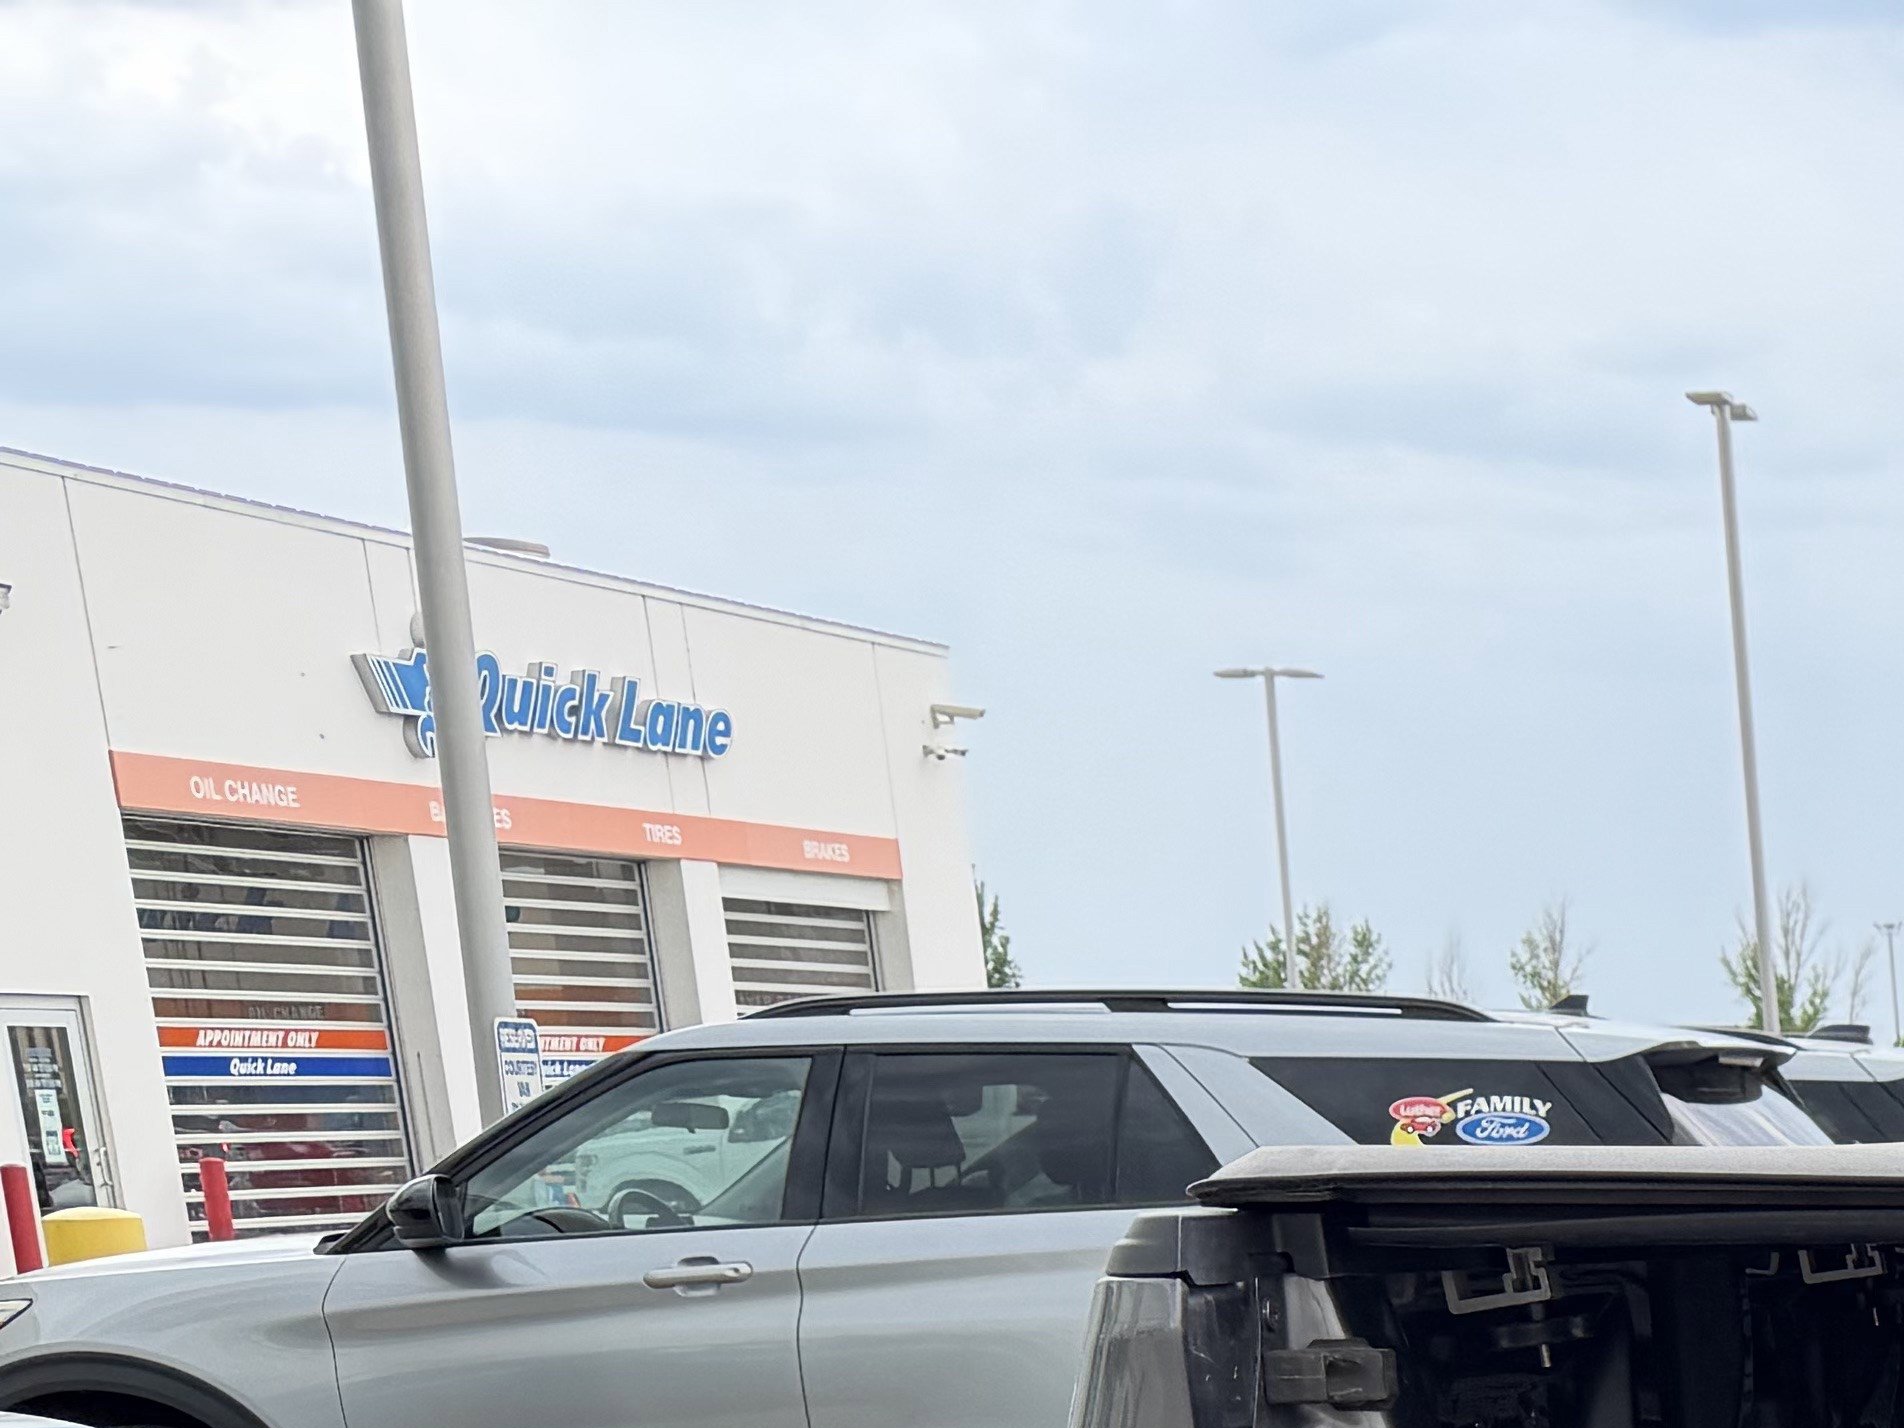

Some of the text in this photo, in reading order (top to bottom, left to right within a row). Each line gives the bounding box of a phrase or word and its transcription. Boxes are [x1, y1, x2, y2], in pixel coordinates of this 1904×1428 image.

[474, 650, 733, 758] Quick Lane
[189, 775, 301, 808] OIL CHANGE
[642, 822, 682, 846] TIRES
[802, 839, 850, 863] BRAKES
[196, 1029, 319, 1048] APPOINTMENT ONLY
[229, 1057, 298, 1076] Quick Lane
[1456, 1095, 1552, 1119] FAMILY
[1475, 1116, 1529, 1140] Ford
